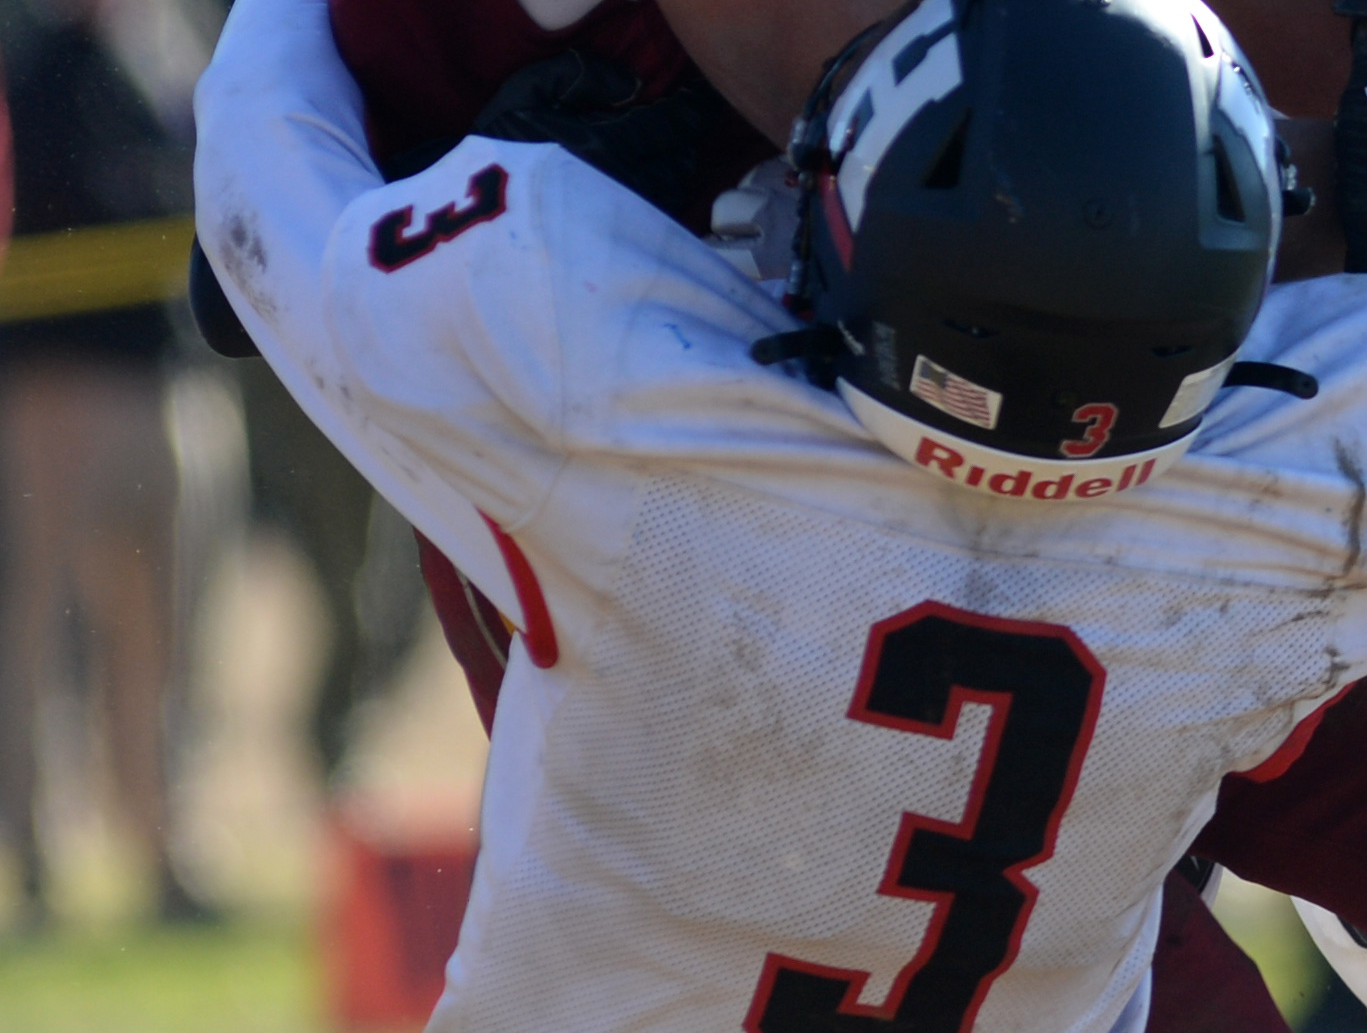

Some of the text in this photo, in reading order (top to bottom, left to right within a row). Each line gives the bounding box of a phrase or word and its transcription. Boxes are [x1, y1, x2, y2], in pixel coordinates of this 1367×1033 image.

[368, 163, 509, 273] 3
[914, 436, 1158, 501] Riddell
[1060, 402, 1120, 458] 3
[744, 598, 1107, 1033] 3
